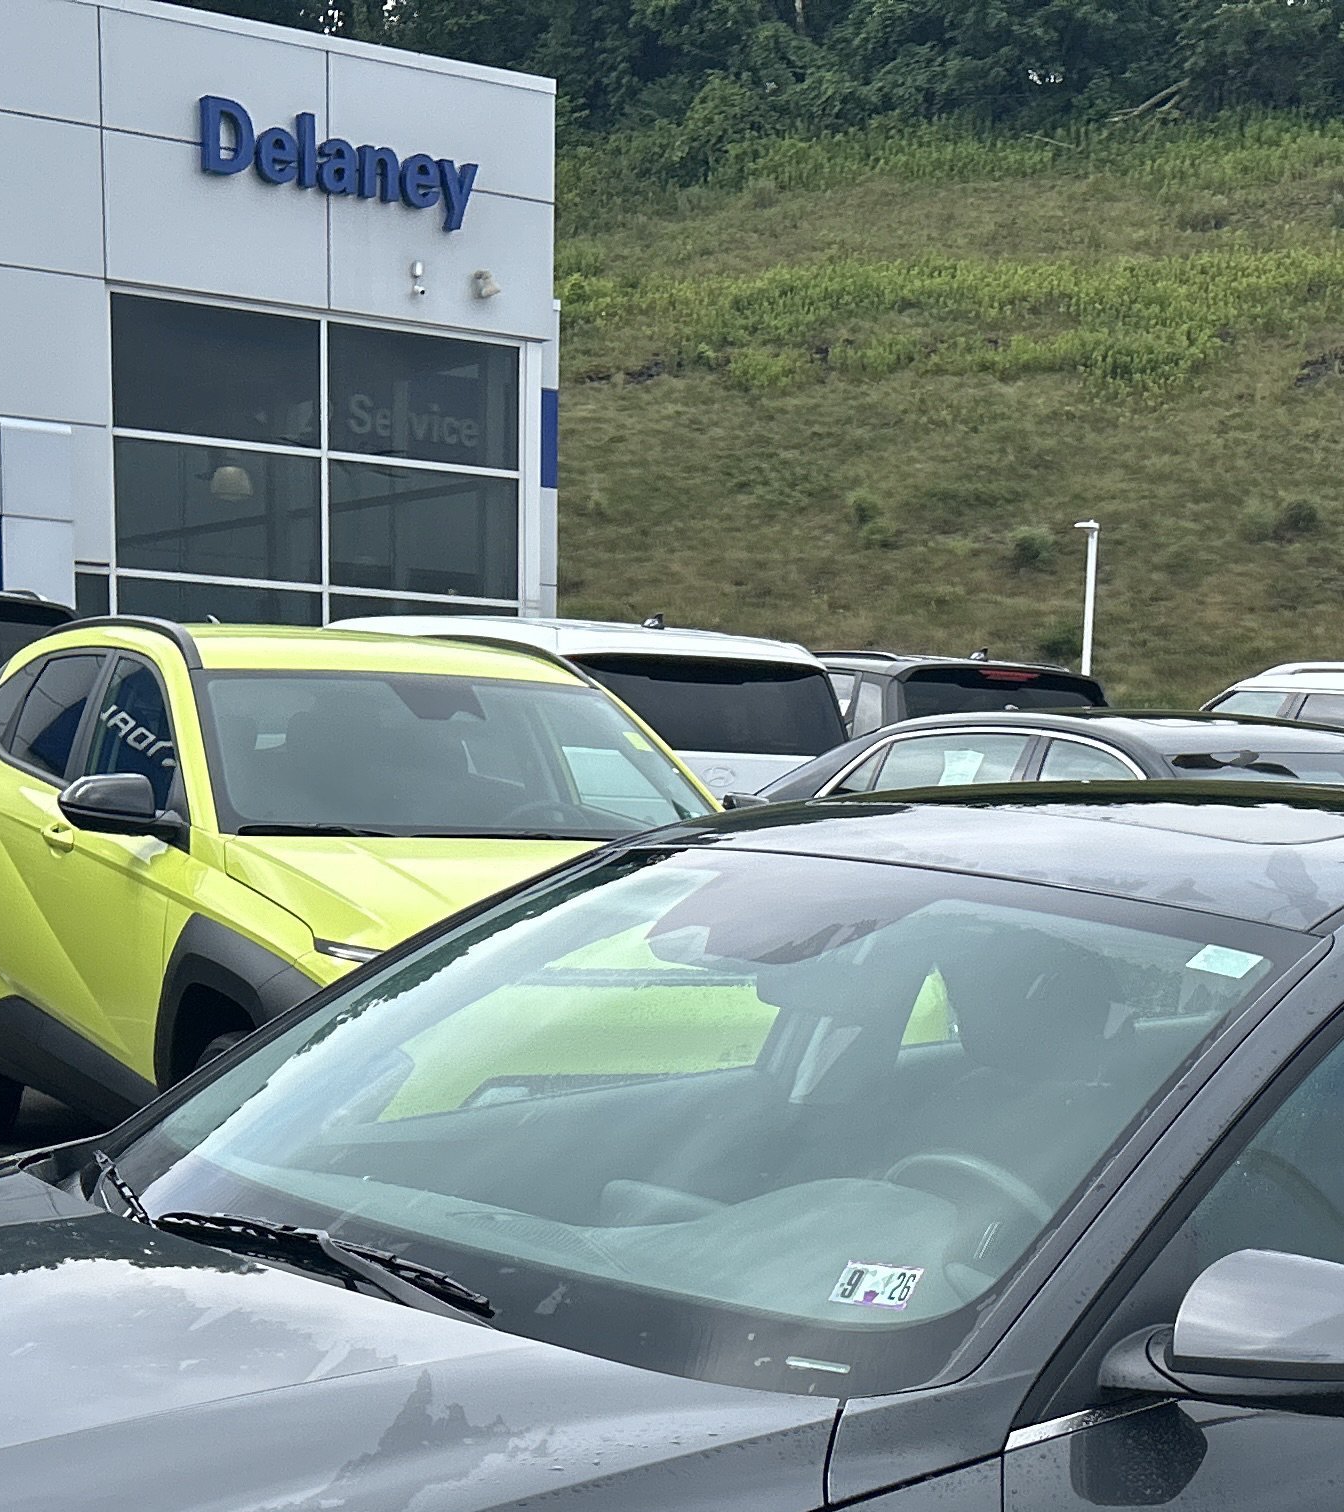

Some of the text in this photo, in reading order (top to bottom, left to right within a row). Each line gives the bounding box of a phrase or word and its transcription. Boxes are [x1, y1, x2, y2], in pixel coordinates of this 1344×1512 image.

[199, 95, 478, 232] Delaney
[347, 393, 479, 447] Sevice
[840, 1269, 917, 1302] 9 26
